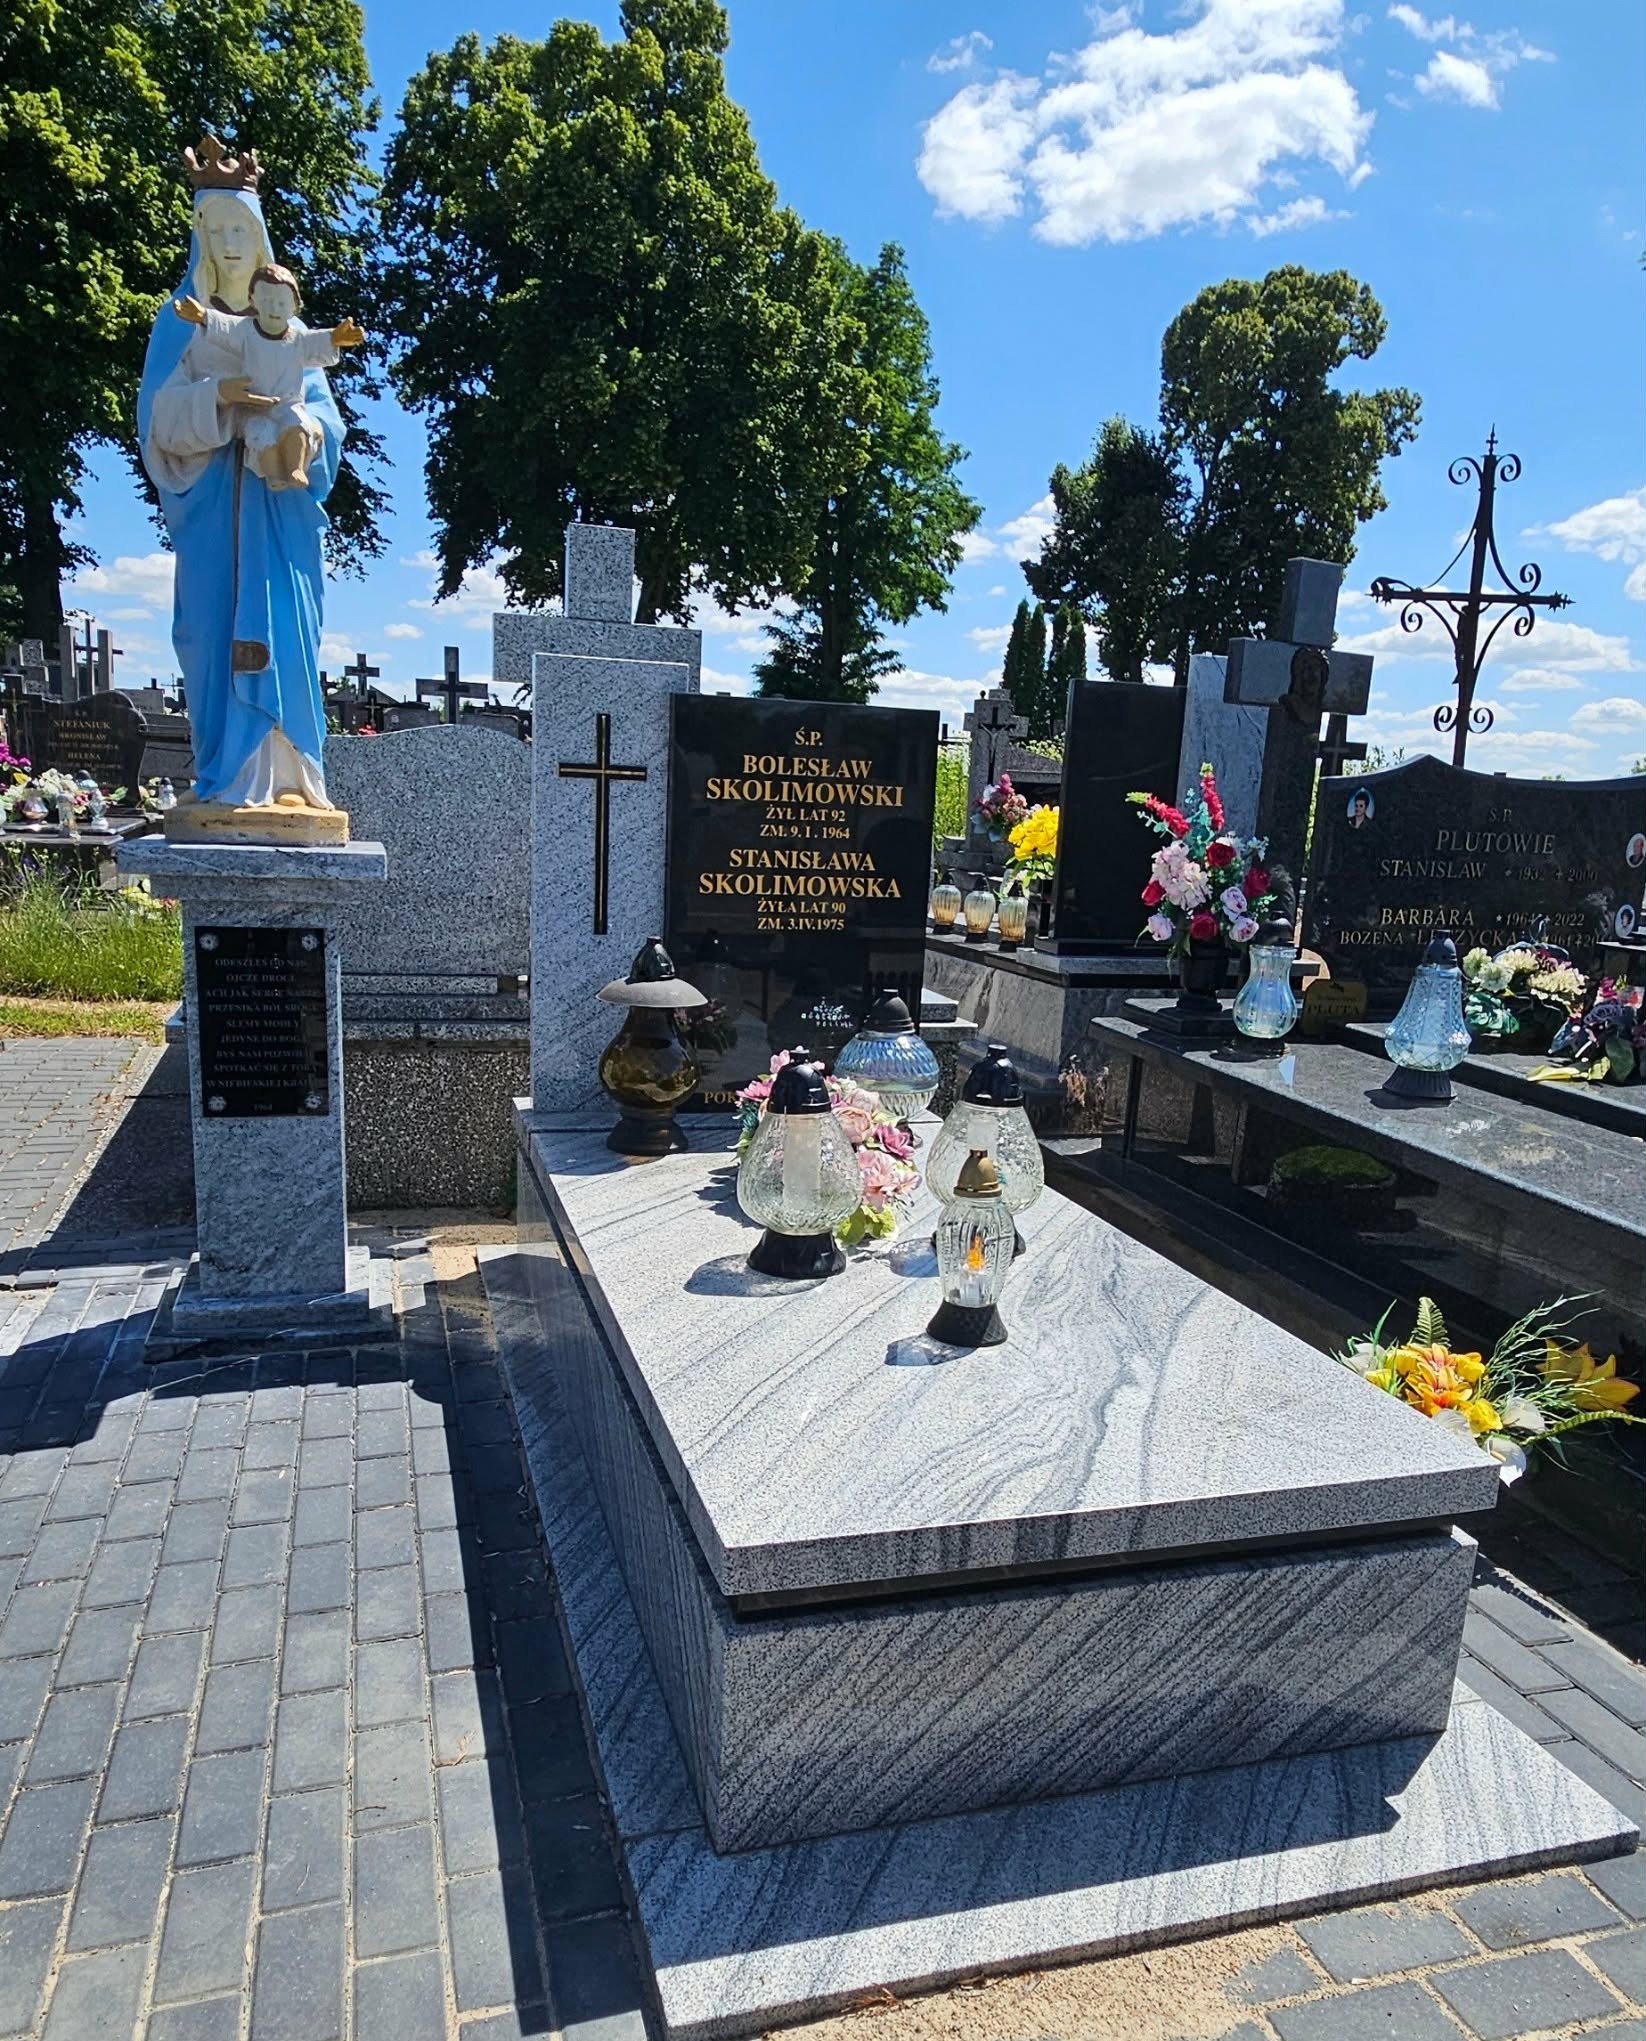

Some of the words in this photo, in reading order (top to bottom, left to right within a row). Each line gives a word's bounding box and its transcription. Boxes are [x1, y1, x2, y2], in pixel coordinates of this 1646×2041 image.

[743, 754, 872, 779] BOLESŁAW
[706, 777, 904, 807] SKOLIMOWSKI
[766, 804, 795, 821] ŻYŁ
[800, 809, 828, 821] LAT
[832, 810, 846, 822] 92
[760, 824, 787, 837] ZM.
[823, 827, 850, 839] 1964
[1434, 829, 1556, 854] PLUTOWIE
[729, 848, 876, 871] STANISŁAWA
[699, 872, 902, 898] SKOLIMOWSKA
[757, 897, 796, 913] ŻYŁA
[800, 901, 829, 913] LAT
[831, 902, 846, 914] 90
[757, 917, 784, 930] ZM.
[1381, 908, 1474, 926] BARBARA
[1554, 912, 1585, 926] 2022
[704, 1091, 737, 1105] POK
